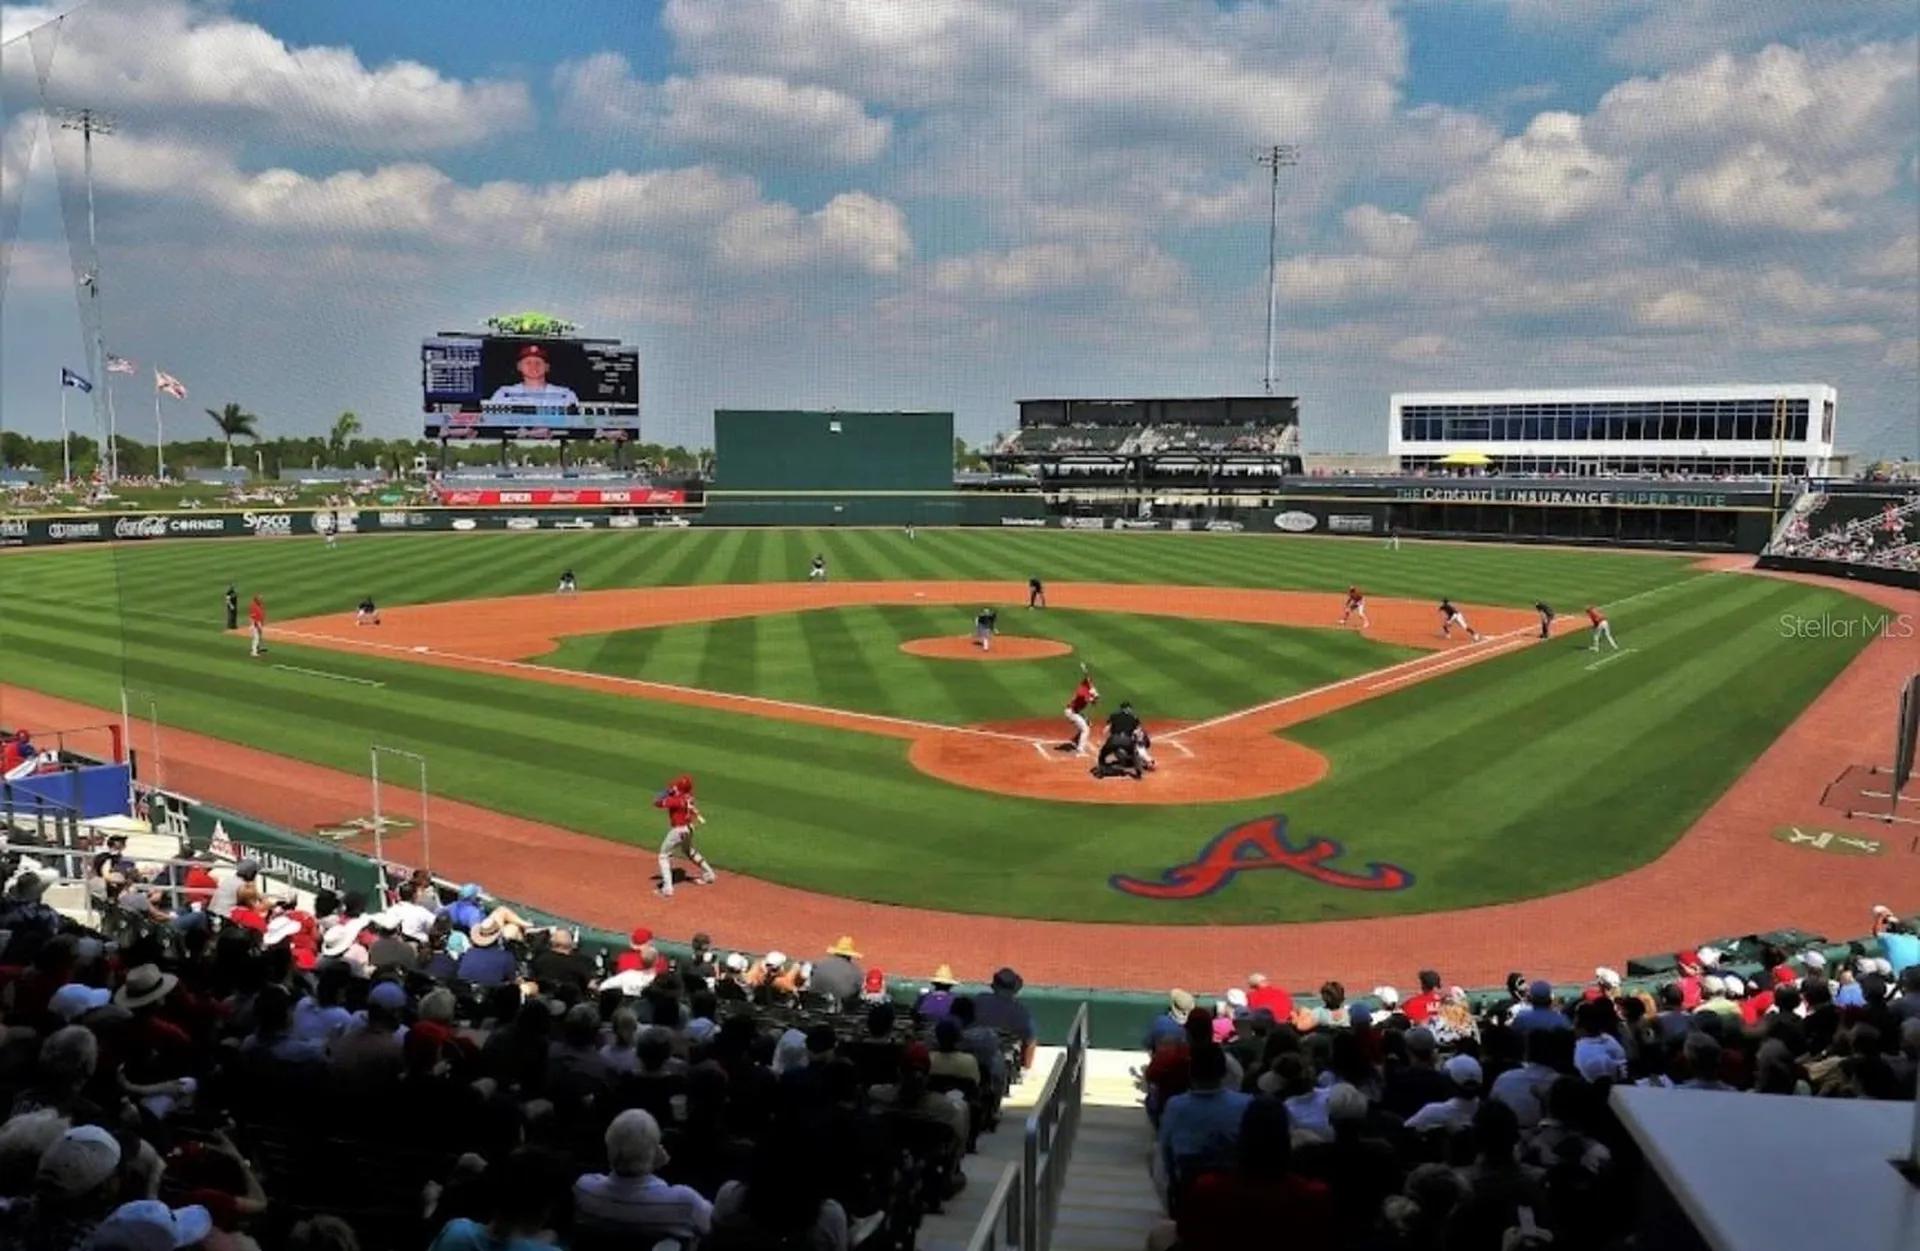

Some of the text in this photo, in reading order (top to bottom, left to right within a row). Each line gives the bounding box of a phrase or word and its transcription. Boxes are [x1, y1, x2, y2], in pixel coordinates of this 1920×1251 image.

[1395, 488, 1420, 500] THE
[1510, 490, 1610, 504] INSURANCE
[1618, 492, 1668, 506] SUPER
[1676, 493, 1726, 508] SUITE
[115, 516, 168, 538] Coca-Cola
[170, 518, 224, 531] CORNER
[243, 511, 291, 530] Sysco
